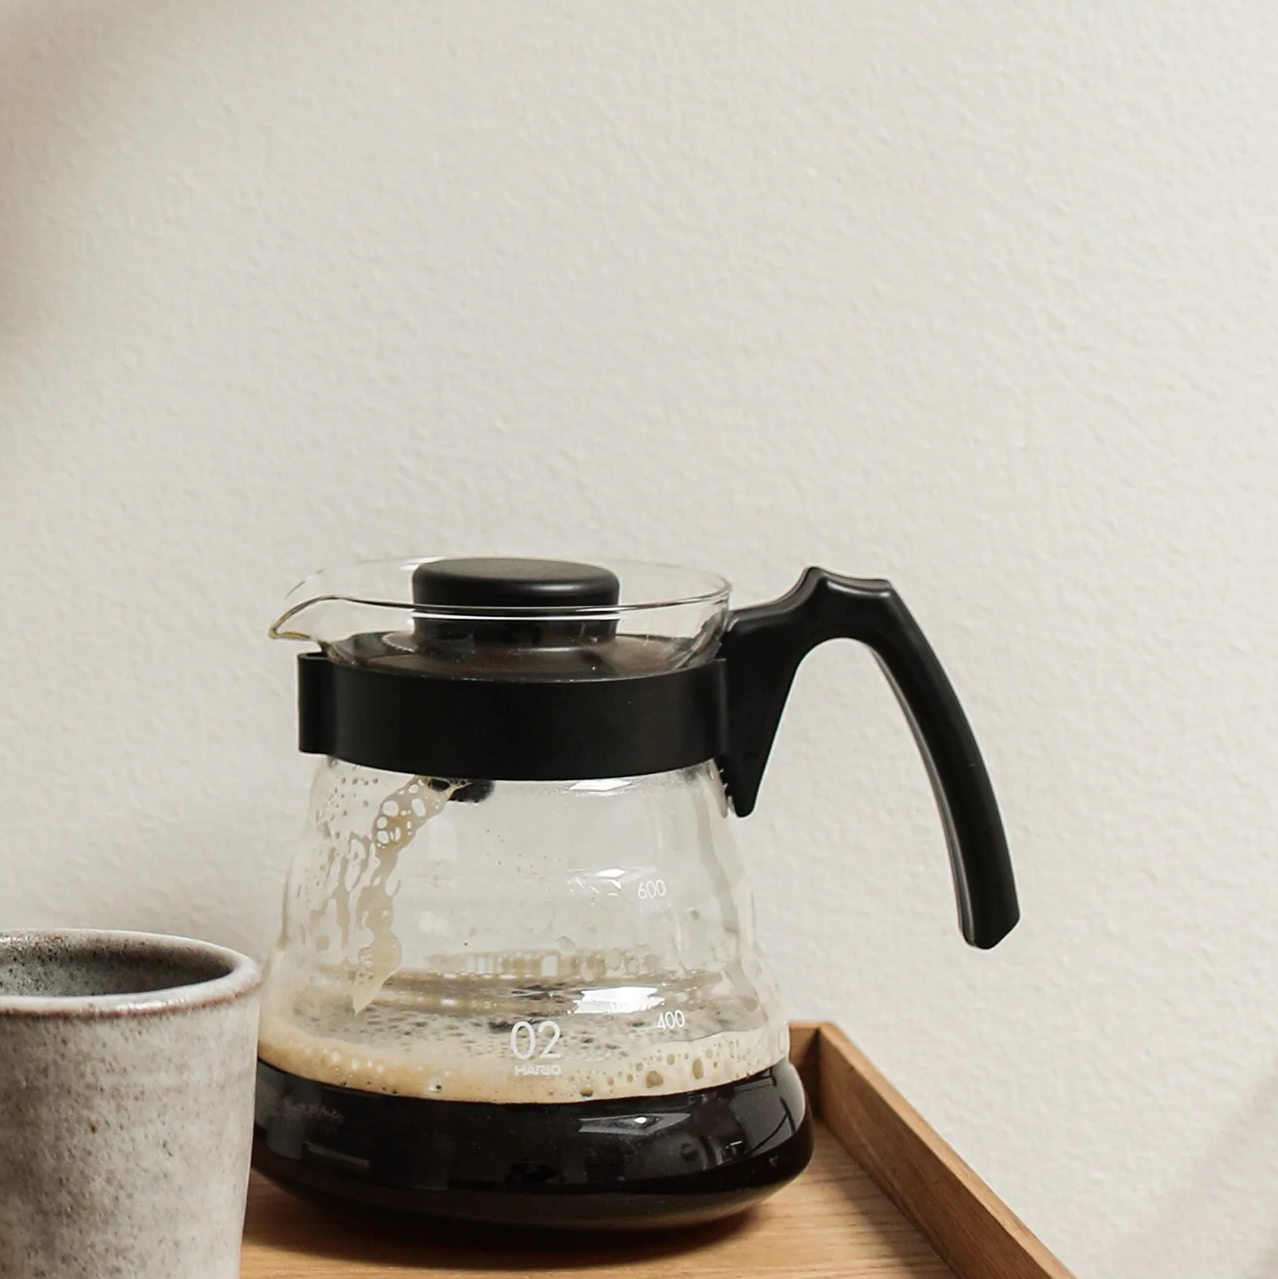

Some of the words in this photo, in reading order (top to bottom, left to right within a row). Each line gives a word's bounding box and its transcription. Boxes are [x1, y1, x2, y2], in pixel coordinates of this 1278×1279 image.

[637, 879, 666, 899] 600
[657, 1009, 686, 1030] 400
[510, 1021, 562, 1061] 02
